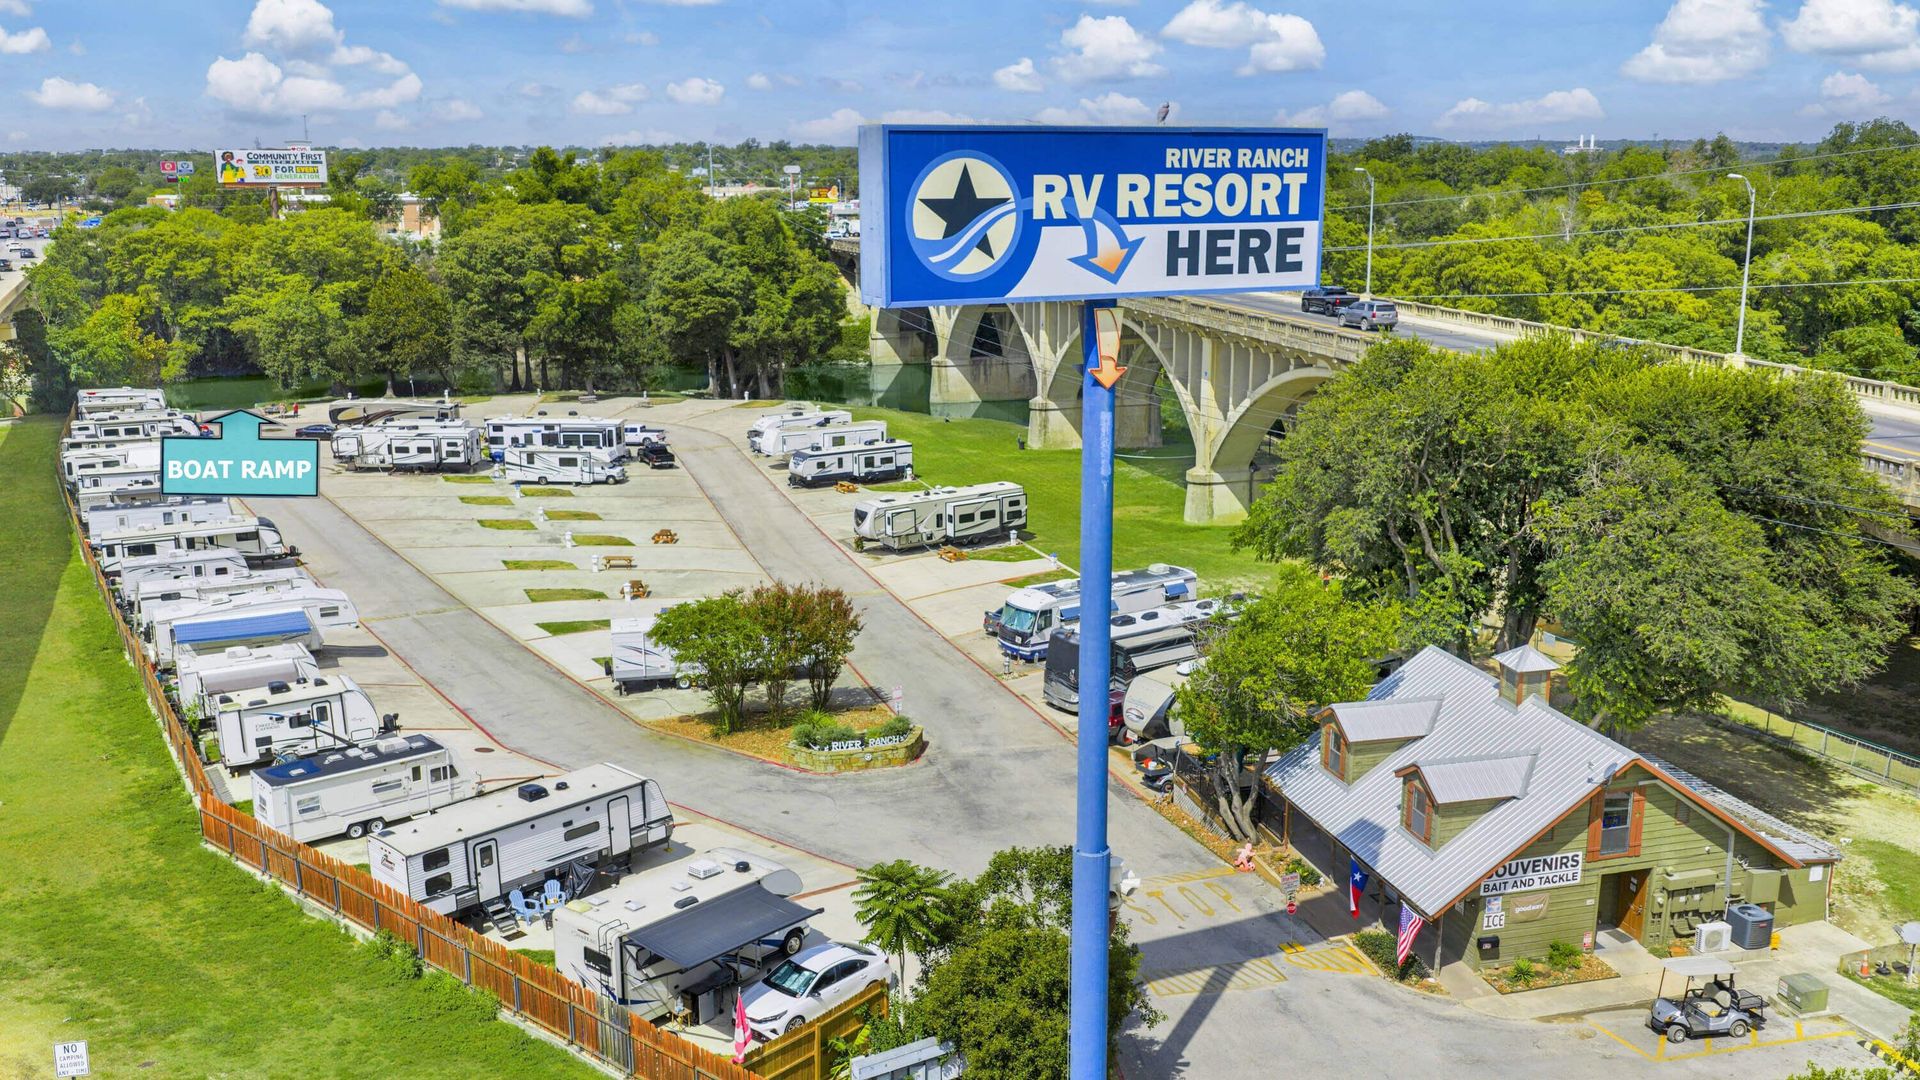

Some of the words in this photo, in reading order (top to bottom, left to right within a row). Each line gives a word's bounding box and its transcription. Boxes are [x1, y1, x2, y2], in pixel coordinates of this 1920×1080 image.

[246, 152, 298, 161] COMMUNITY
[300, 152, 323, 161] FIRST
[1165, 148, 1234, 168] RIVER
[1237, 148, 1309, 168] RANCH
[1032, 173, 1104, 220] RV
[1116, 172, 1308, 218] RESORT
[1166, 227, 1305, 277] HERE
[832, 741, 862, 751] RIVER
[869, 735, 899, 748] RANCH
[1487, 854, 1579, 879] OUVENIRS
[1483, 880, 1509, 893] BAIT
[1511, 877, 1535, 890] AND
[1538, 872, 1579, 886] TACKLE
[1122, 882, 1242, 925] STOP
[1485, 914, 1504, 928] ICE
[64, 1044, 77, 1053] NO
